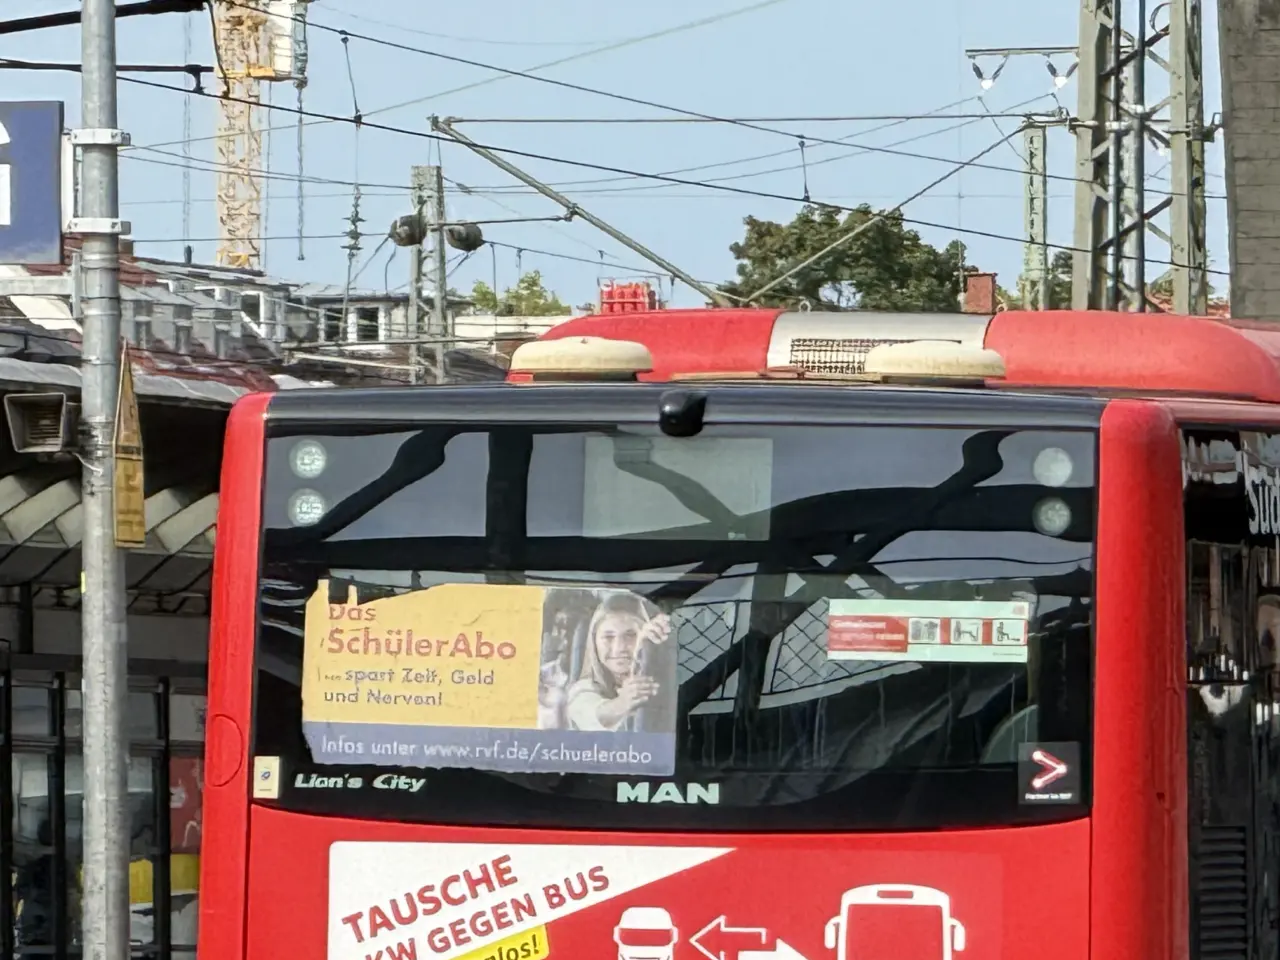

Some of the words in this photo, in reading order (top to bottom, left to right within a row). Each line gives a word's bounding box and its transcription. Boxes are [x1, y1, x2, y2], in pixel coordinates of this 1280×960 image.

[328, 604, 377, 622] Das
[327, 626, 517, 660] SchülerAbo
[450, 668, 495, 686] Geld
[323, 686, 360, 704] und
[321, 735, 364, 756] Infos
[371, 740, 417, 757] unter
[423, 739, 653, 765] www.rvf.de/schuelerabo
[294, 773, 362, 790] Lion's
[373, 773, 427, 793] City
[616, 781, 721, 805] MAN
[341, 854, 519, 944] TAUSCHE
[427, 892, 537, 954] GEGEN
[542, 865, 610, 910] BUS
